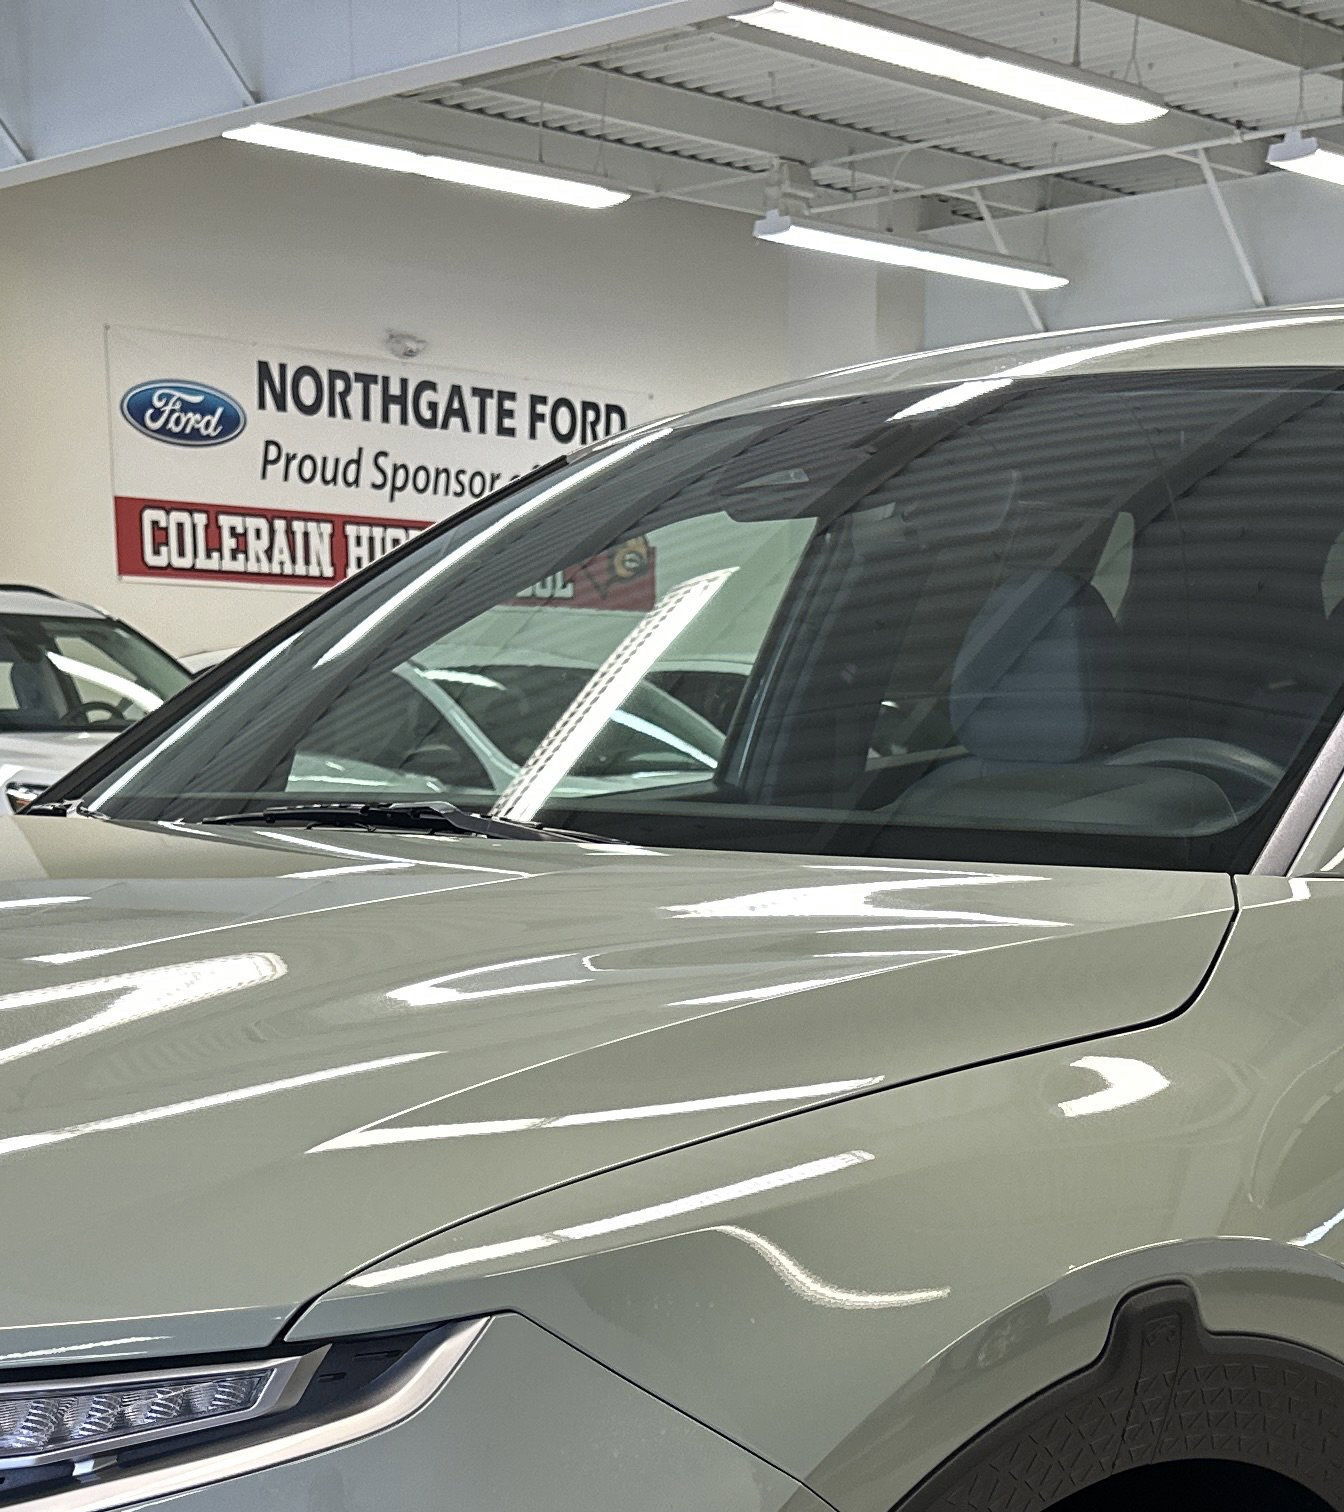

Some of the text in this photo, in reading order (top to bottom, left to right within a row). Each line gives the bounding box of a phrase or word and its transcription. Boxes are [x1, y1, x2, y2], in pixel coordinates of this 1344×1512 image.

[144, 388, 224, 437] Ford
[257, 360, 627, 445] NORTHGATE FORD
[260, 439, 502, 502] Proud Sponsor
[141, 507, 335, 578] COLERAIN
